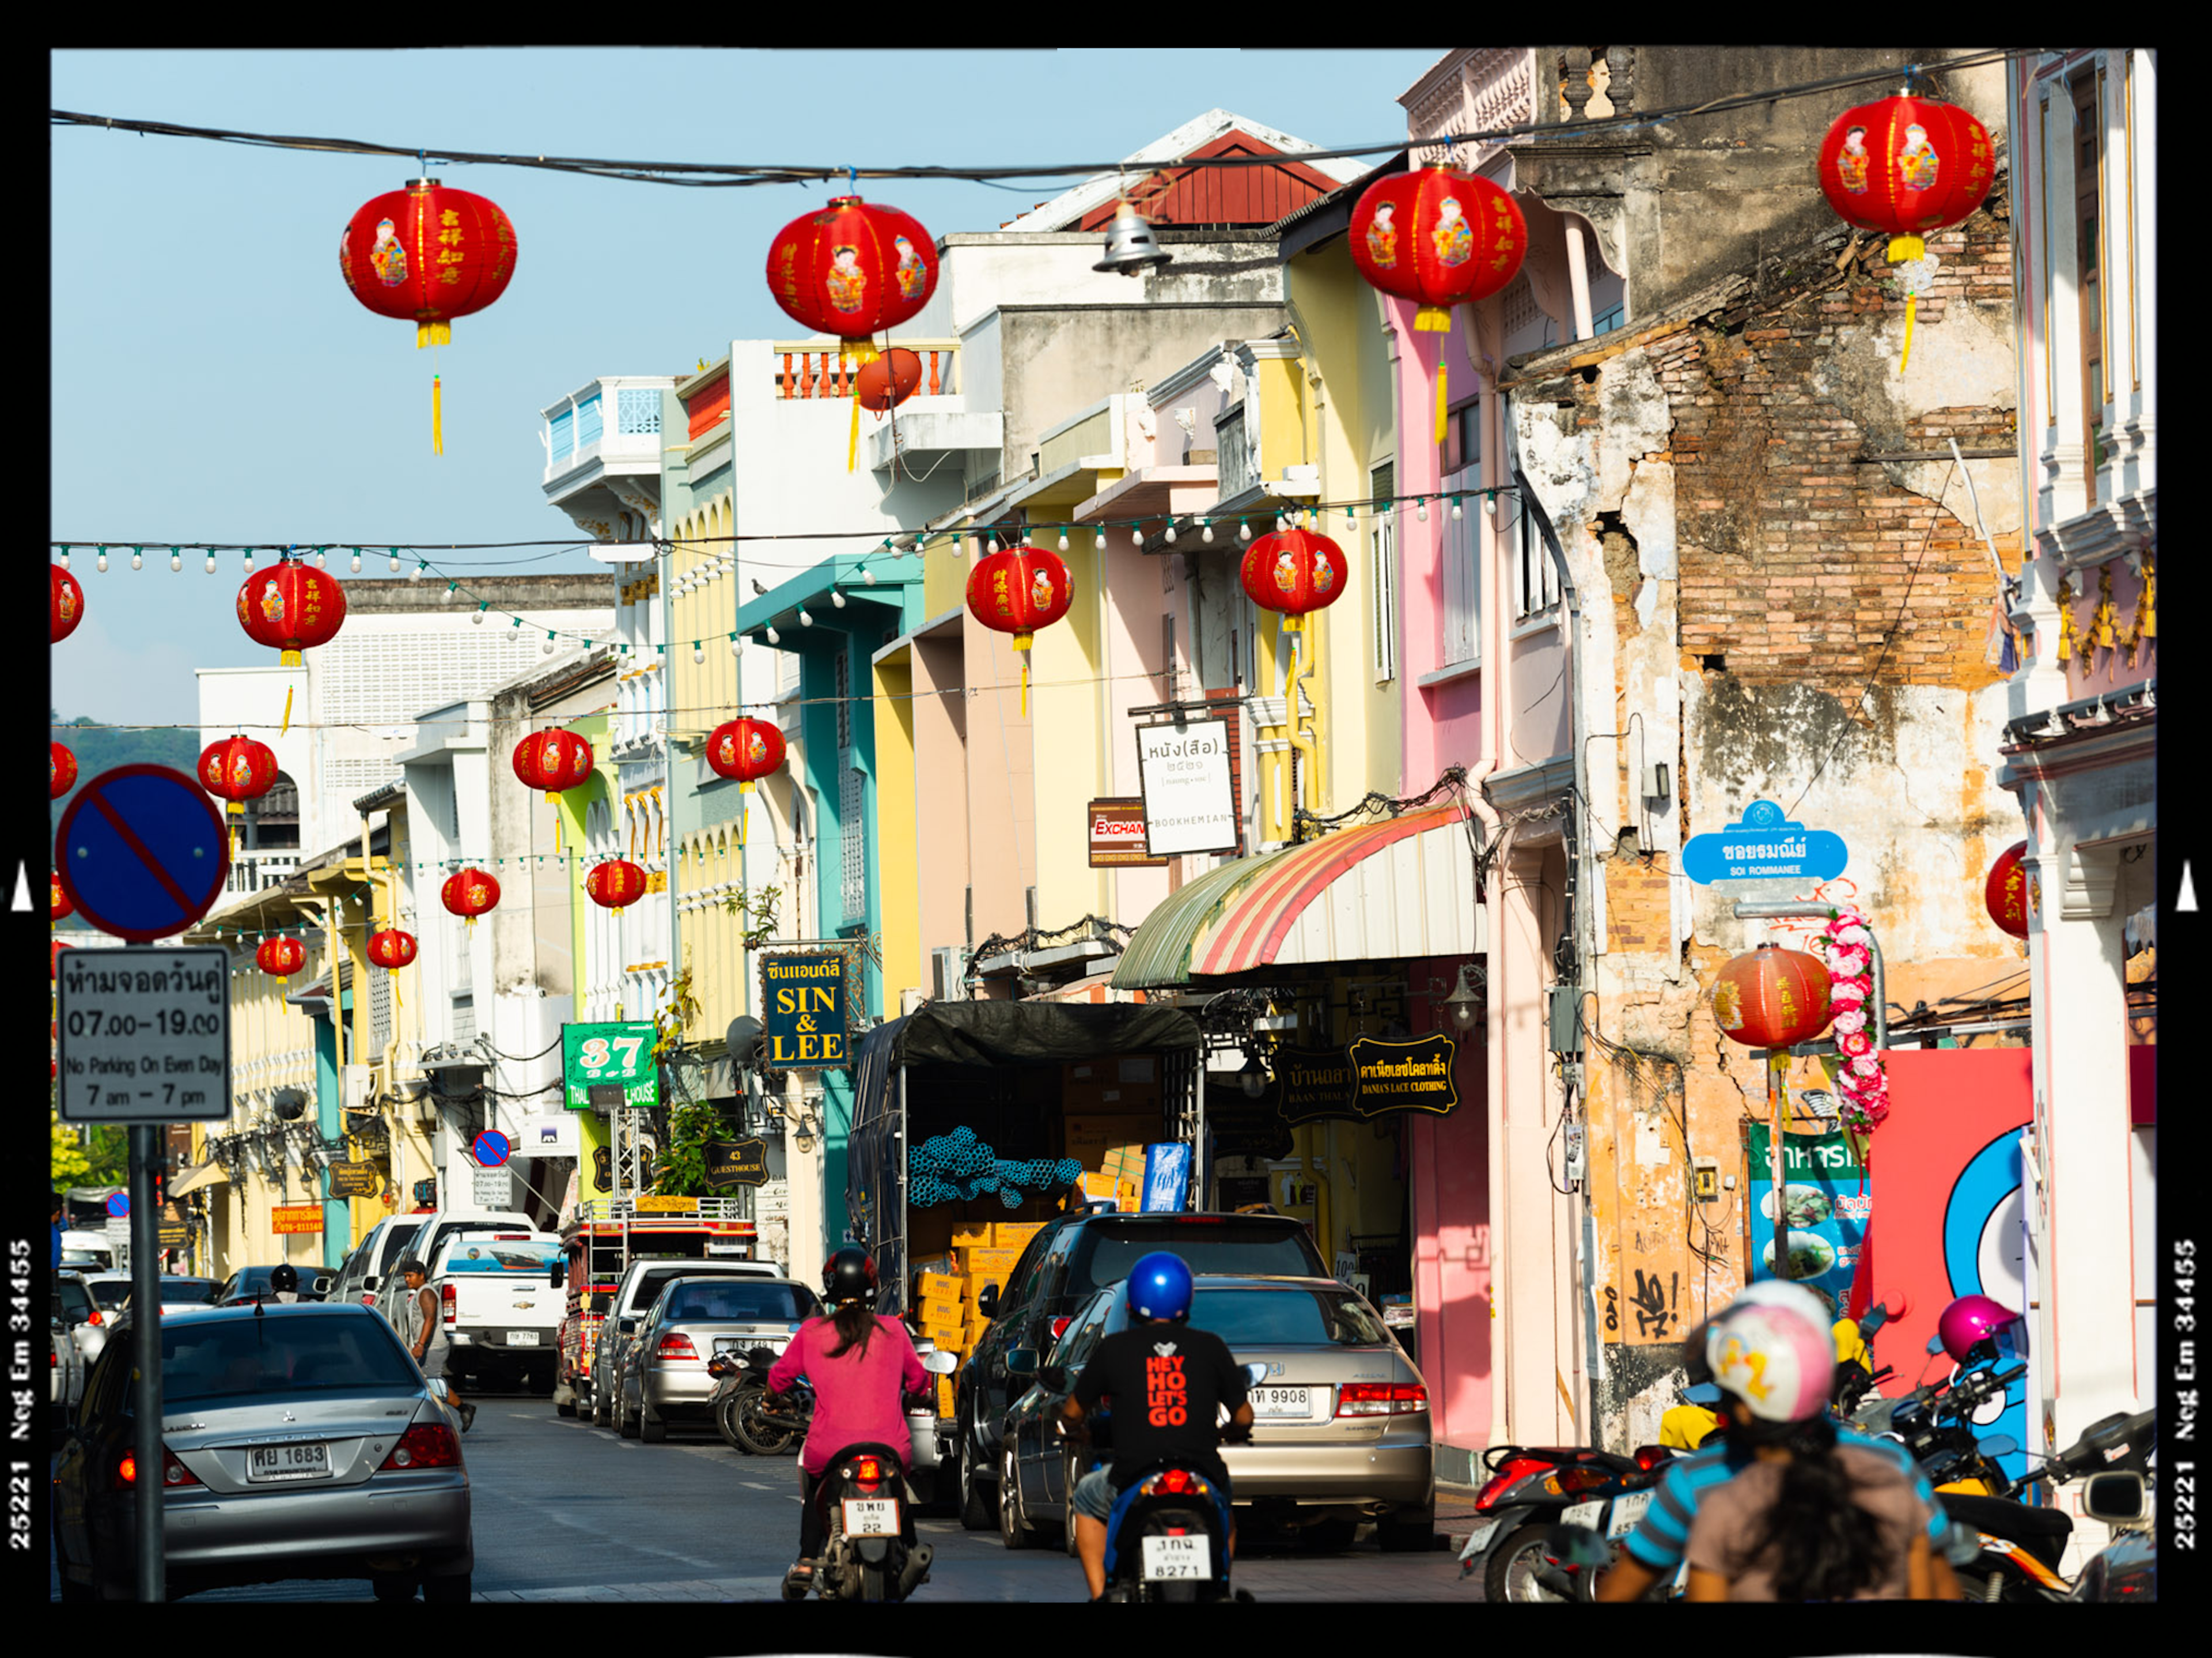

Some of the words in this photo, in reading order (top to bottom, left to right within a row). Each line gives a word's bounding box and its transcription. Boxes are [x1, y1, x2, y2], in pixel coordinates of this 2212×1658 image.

[437, 208, 465, 285] 吉祥如意
[304, 578, 321, 626] 吉祥如意
[993, 569, 1014, 617] 財源廣進
[1096, 820, 1145, 835] EXCHAN
[1154, 815, 1228, 828] BOOKHEMIAN
[1722, 836, 1807, 860] ซอยรมณีย์
[1729, 866, 1747, 876] SOI
[1749, 865, 1802, 875] ROMMANEE
[767, 957, 841, 979] ซินแอนด์ลี
[66, 959, 221, 1004] ห้ามจอดวันคู่
[777, 987, 836, 1015] SIN
[796, 1014, 818, 1033] &
[579, 1036, 645, 1069] 37
[771, 1034, 844, 1061] LEE
[67, 1058, 84, 1074] No
[89, 1056, 136, 1077] Parking
[141, 1056, 159, 1073] On
[164, 1055, 194, 1073] Even
[199, 1055, 224, 1076] Day
[1289, 1063, 1352, 1087] บ้านถลา
[86, 1084, 100, 1106] 7
[107, 1091, 130, 1106] am
[162, 1083, 176, 1104] 7
[181, 1090, 205, 1108] pm
[631, 1080, 655, 1103] HOUSE
[1391, 1082, 1410, 1093] LACE
[1410, 1080, 1447, 1092] CLOTHING
[729, 1150, 741, 1160] 43
[710, 1163, 762, 1175] GUESTHOUSE
[936, 1280, 950, 1289] BWG
[937, 1305, 950, 1313] BWG
[938, 1330, 952, 1338] BWG
[1147, 1356, 1185, 1372] HEY
[1147, 1372, 1187, 1391] HO
[1147, 1390, 1187, 1408] LET'S
[1271, 1390, 1307, 1404] 9908
[1148, 1406, 1188, 1427] GO
[286, 1446, 324, 1465] 1683
[863, 1523, 882, 1533] 22
[1156, 1566, 1199, 1577] 8271
